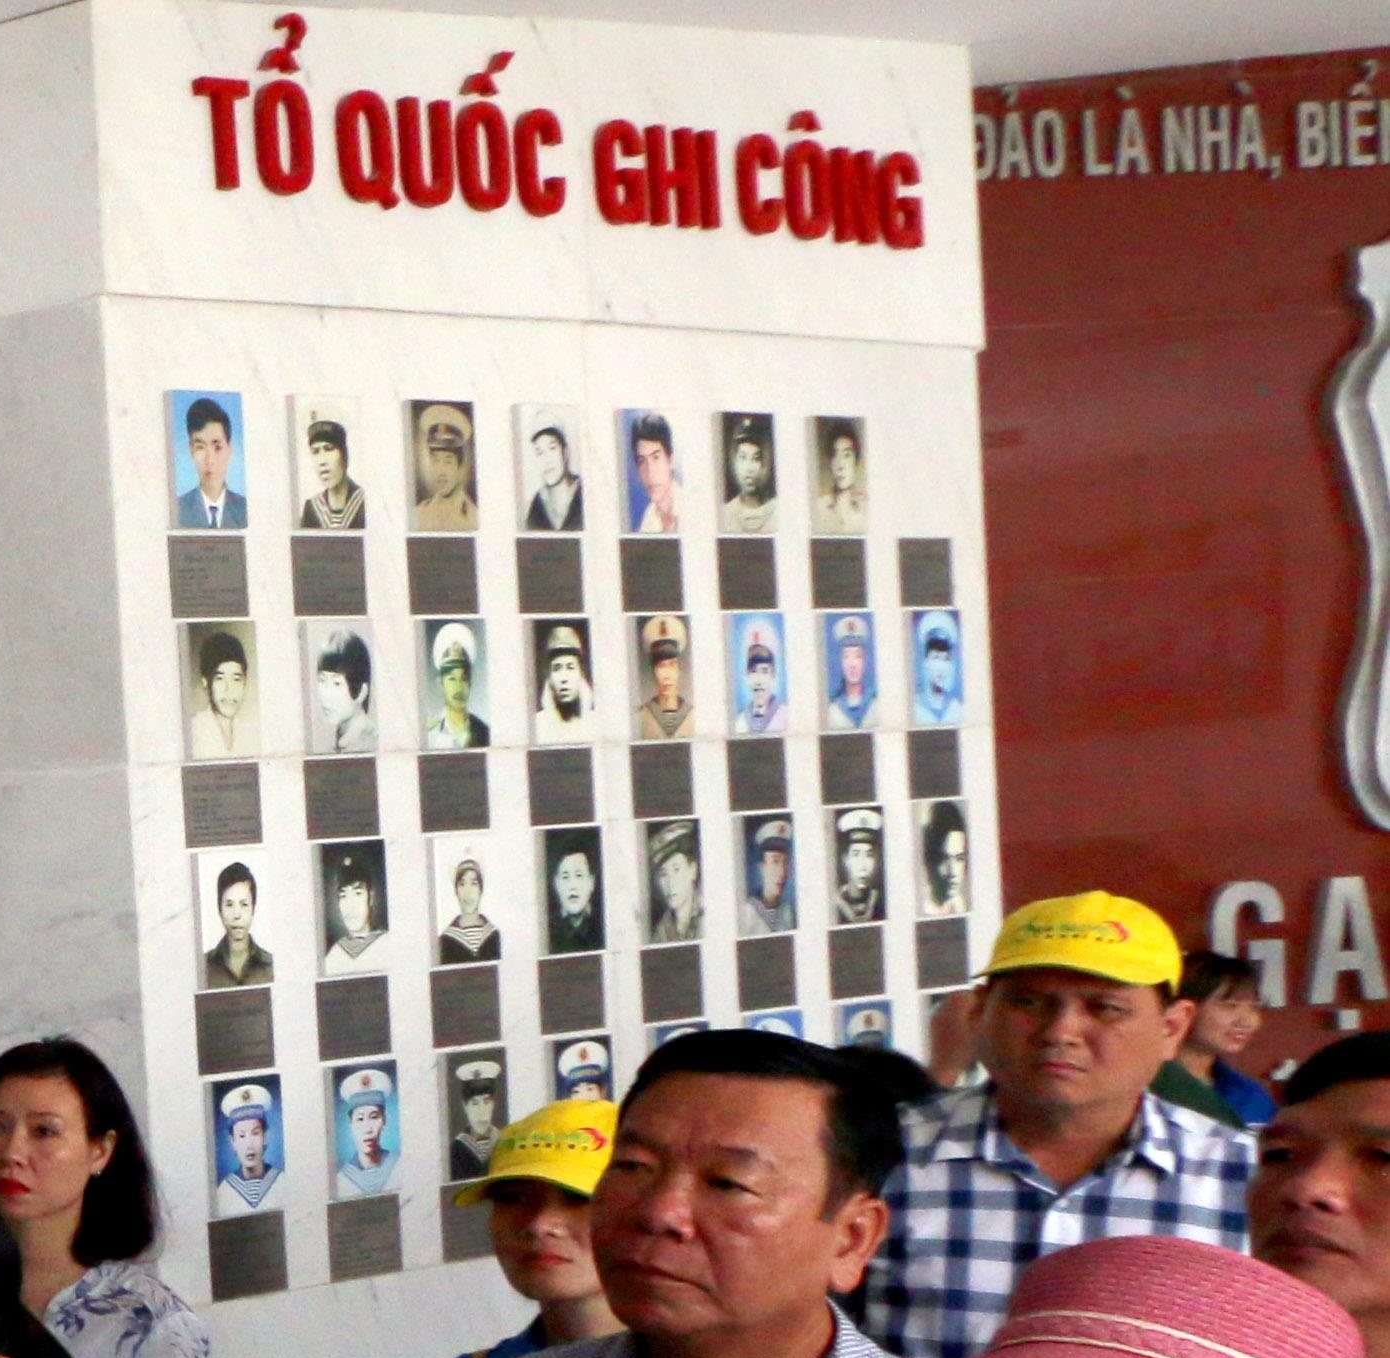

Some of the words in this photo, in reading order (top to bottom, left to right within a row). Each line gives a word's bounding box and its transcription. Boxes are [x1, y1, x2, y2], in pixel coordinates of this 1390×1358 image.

[192, 13, 314, 195] TỔ
[335, 51, 566, 217] QUỐC
[592, 119, 721, 229] GHI
[735, 109, 924, 249] CÔNG
[974, 83, 1068, 181] ĐẢO
[1082, 85, 1151, 176] LÀ
[1162, 79, 1282, 179] NHÀ,
